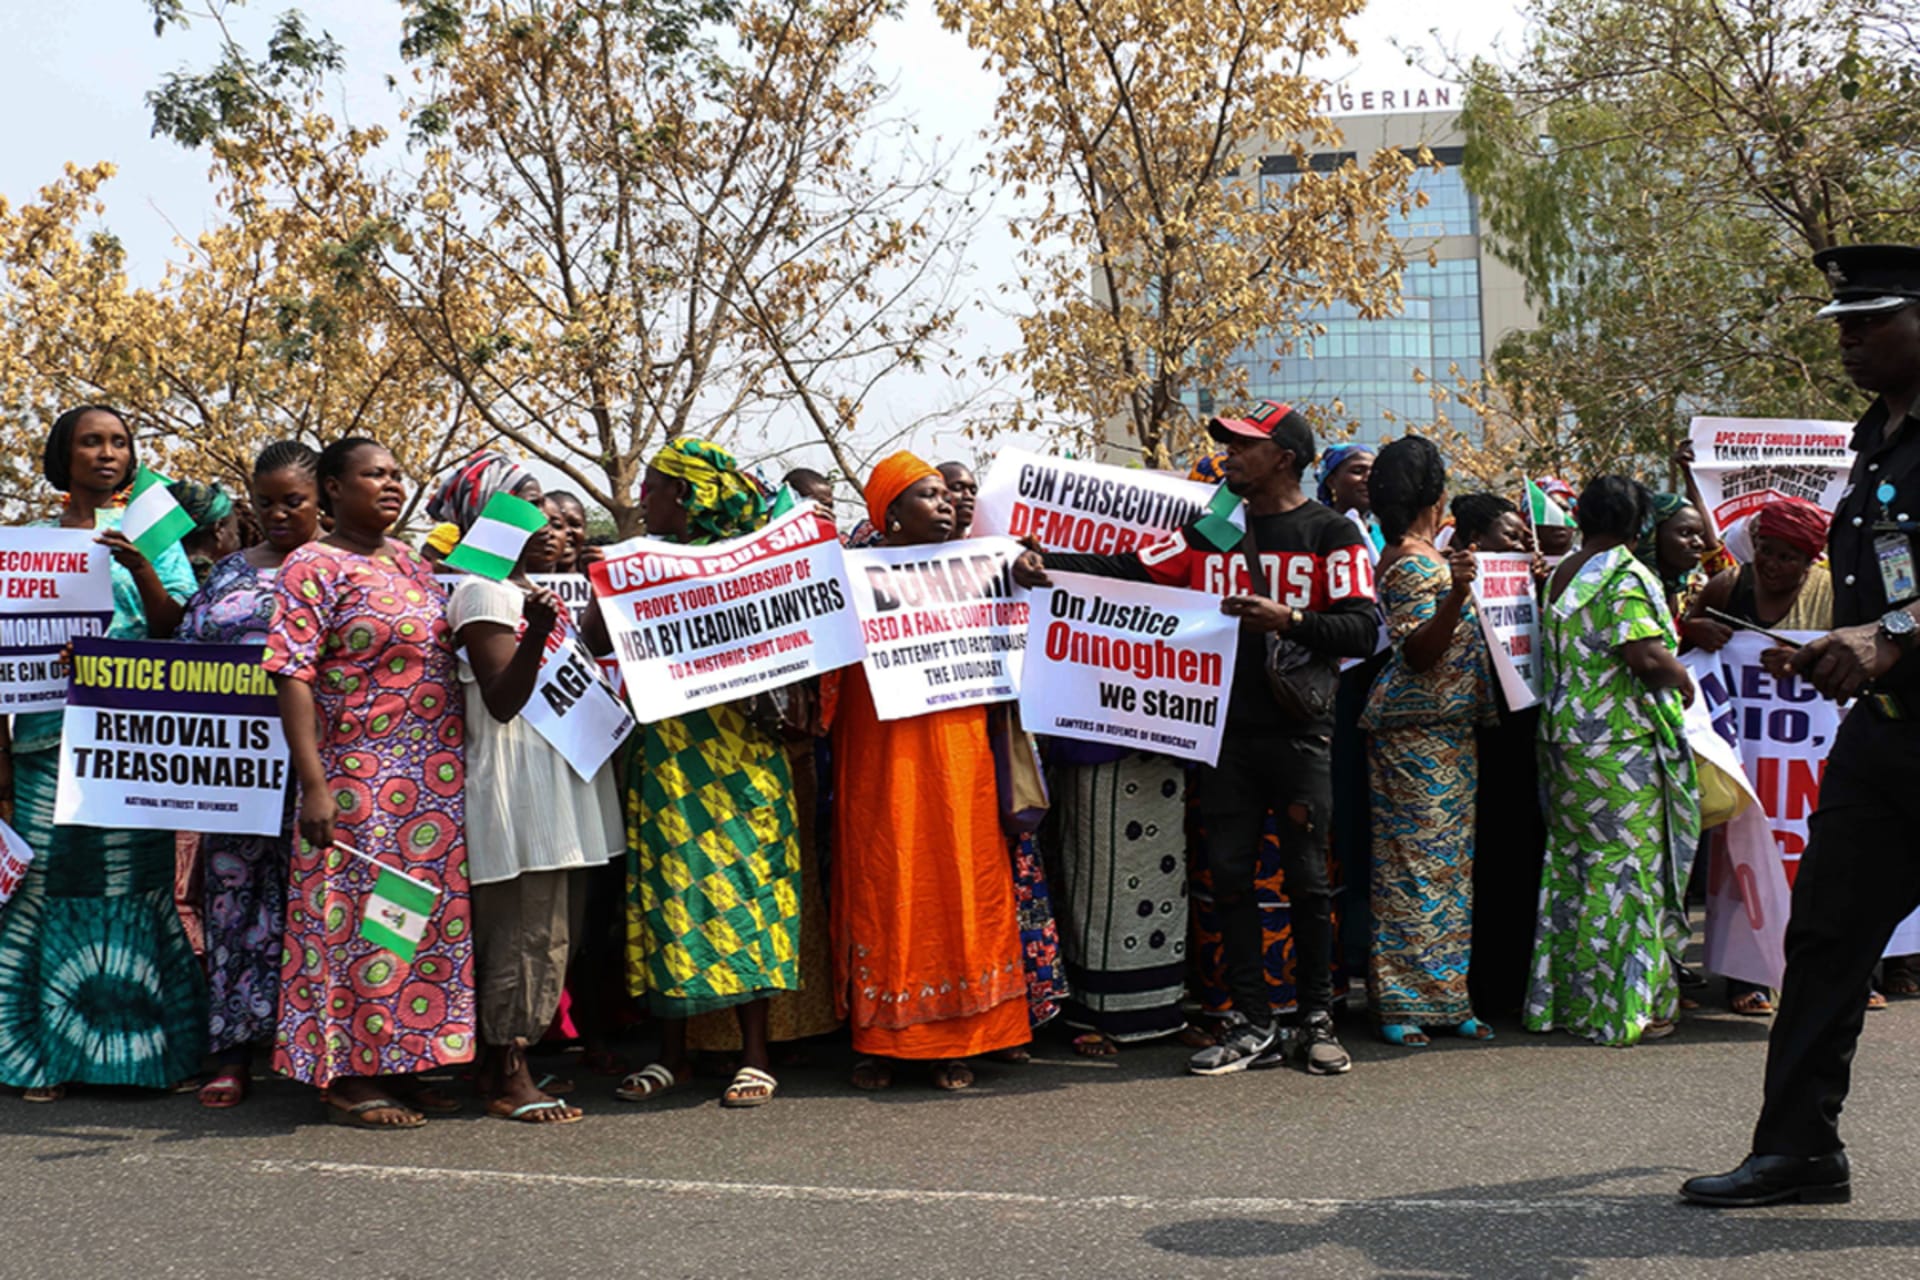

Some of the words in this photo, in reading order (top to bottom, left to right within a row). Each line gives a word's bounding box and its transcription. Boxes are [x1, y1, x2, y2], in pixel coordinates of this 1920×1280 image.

[1308, 88, 1450, 112] IGERIAN
[1713, 445, 1759, 460] TANKO
[1715, 431, 1737, 445] APC
[1738, 432, 1763, 445] GOVT
[1803, 434, 1846, 448] APPOINT
[1018, 463, 1058, 500] CJN
[702, 544, 768, 574] PAUL
[768, 514, 821, 549] SAN
[7, 578, 59, 598] EXPEL
[633, 596, 680, 622] PROVE
[680, 586, 718, 611] YOUR
[718, 563, 793, 602] LEADERSHIP
[793, 558, 812, 580] OF
[864, 552, 1013, 613] BUHARI
[619, 624, 661, 663] NBA
[658, 617, 685, 657] BY
[684, 602, 763, 651] LEADING
[760, 577, 846, 629] LAWYERS
[902, 614, 914, 639] A
[914, 608, 953, 636] FAKE
[951, 603, 994, 630] COURT
[1050, 588, 1086, 621] On
[1087, 595, 1180, 637] Justice
[668, 663, 684, 681] TO
[684, 660, 695, 677] A
[694, 649, 747, 675] HISTORIC
[748, 638, 776, 662] SHUT
[872, 651, 890, 670] TO
[892, 640, 949, 667] ATTEMPT
[950, 639, 967, 656] TO
[968, 632, 1028, 654] FACTIONALIS
[1045, 620, 1223, 687] Onnoghen
[18, 662, 47, 682] CJN
[74, 656, 166, 692] JUSTICE
[924, 667, 952, 687] THE
[953, 660, 1004, 682] JUDICIARY
[1099, 682, 1137, 713] we
[1142, 689, 1219, 728] stand
[95, 711, 230, 749] REMOVAL
[238, 719, 270, 750] IS
[1055, 716, 1094, 732] LAWYERS
[1095, 723, 1105, 734] IN
[1105, 724, 1139, 739] DEFENCE
[1139, 729, 1150, 740] OF
[1150, 730, 1198, 750] DEMOCRACY
[73, 748, 285, 790] TREASONABLE
